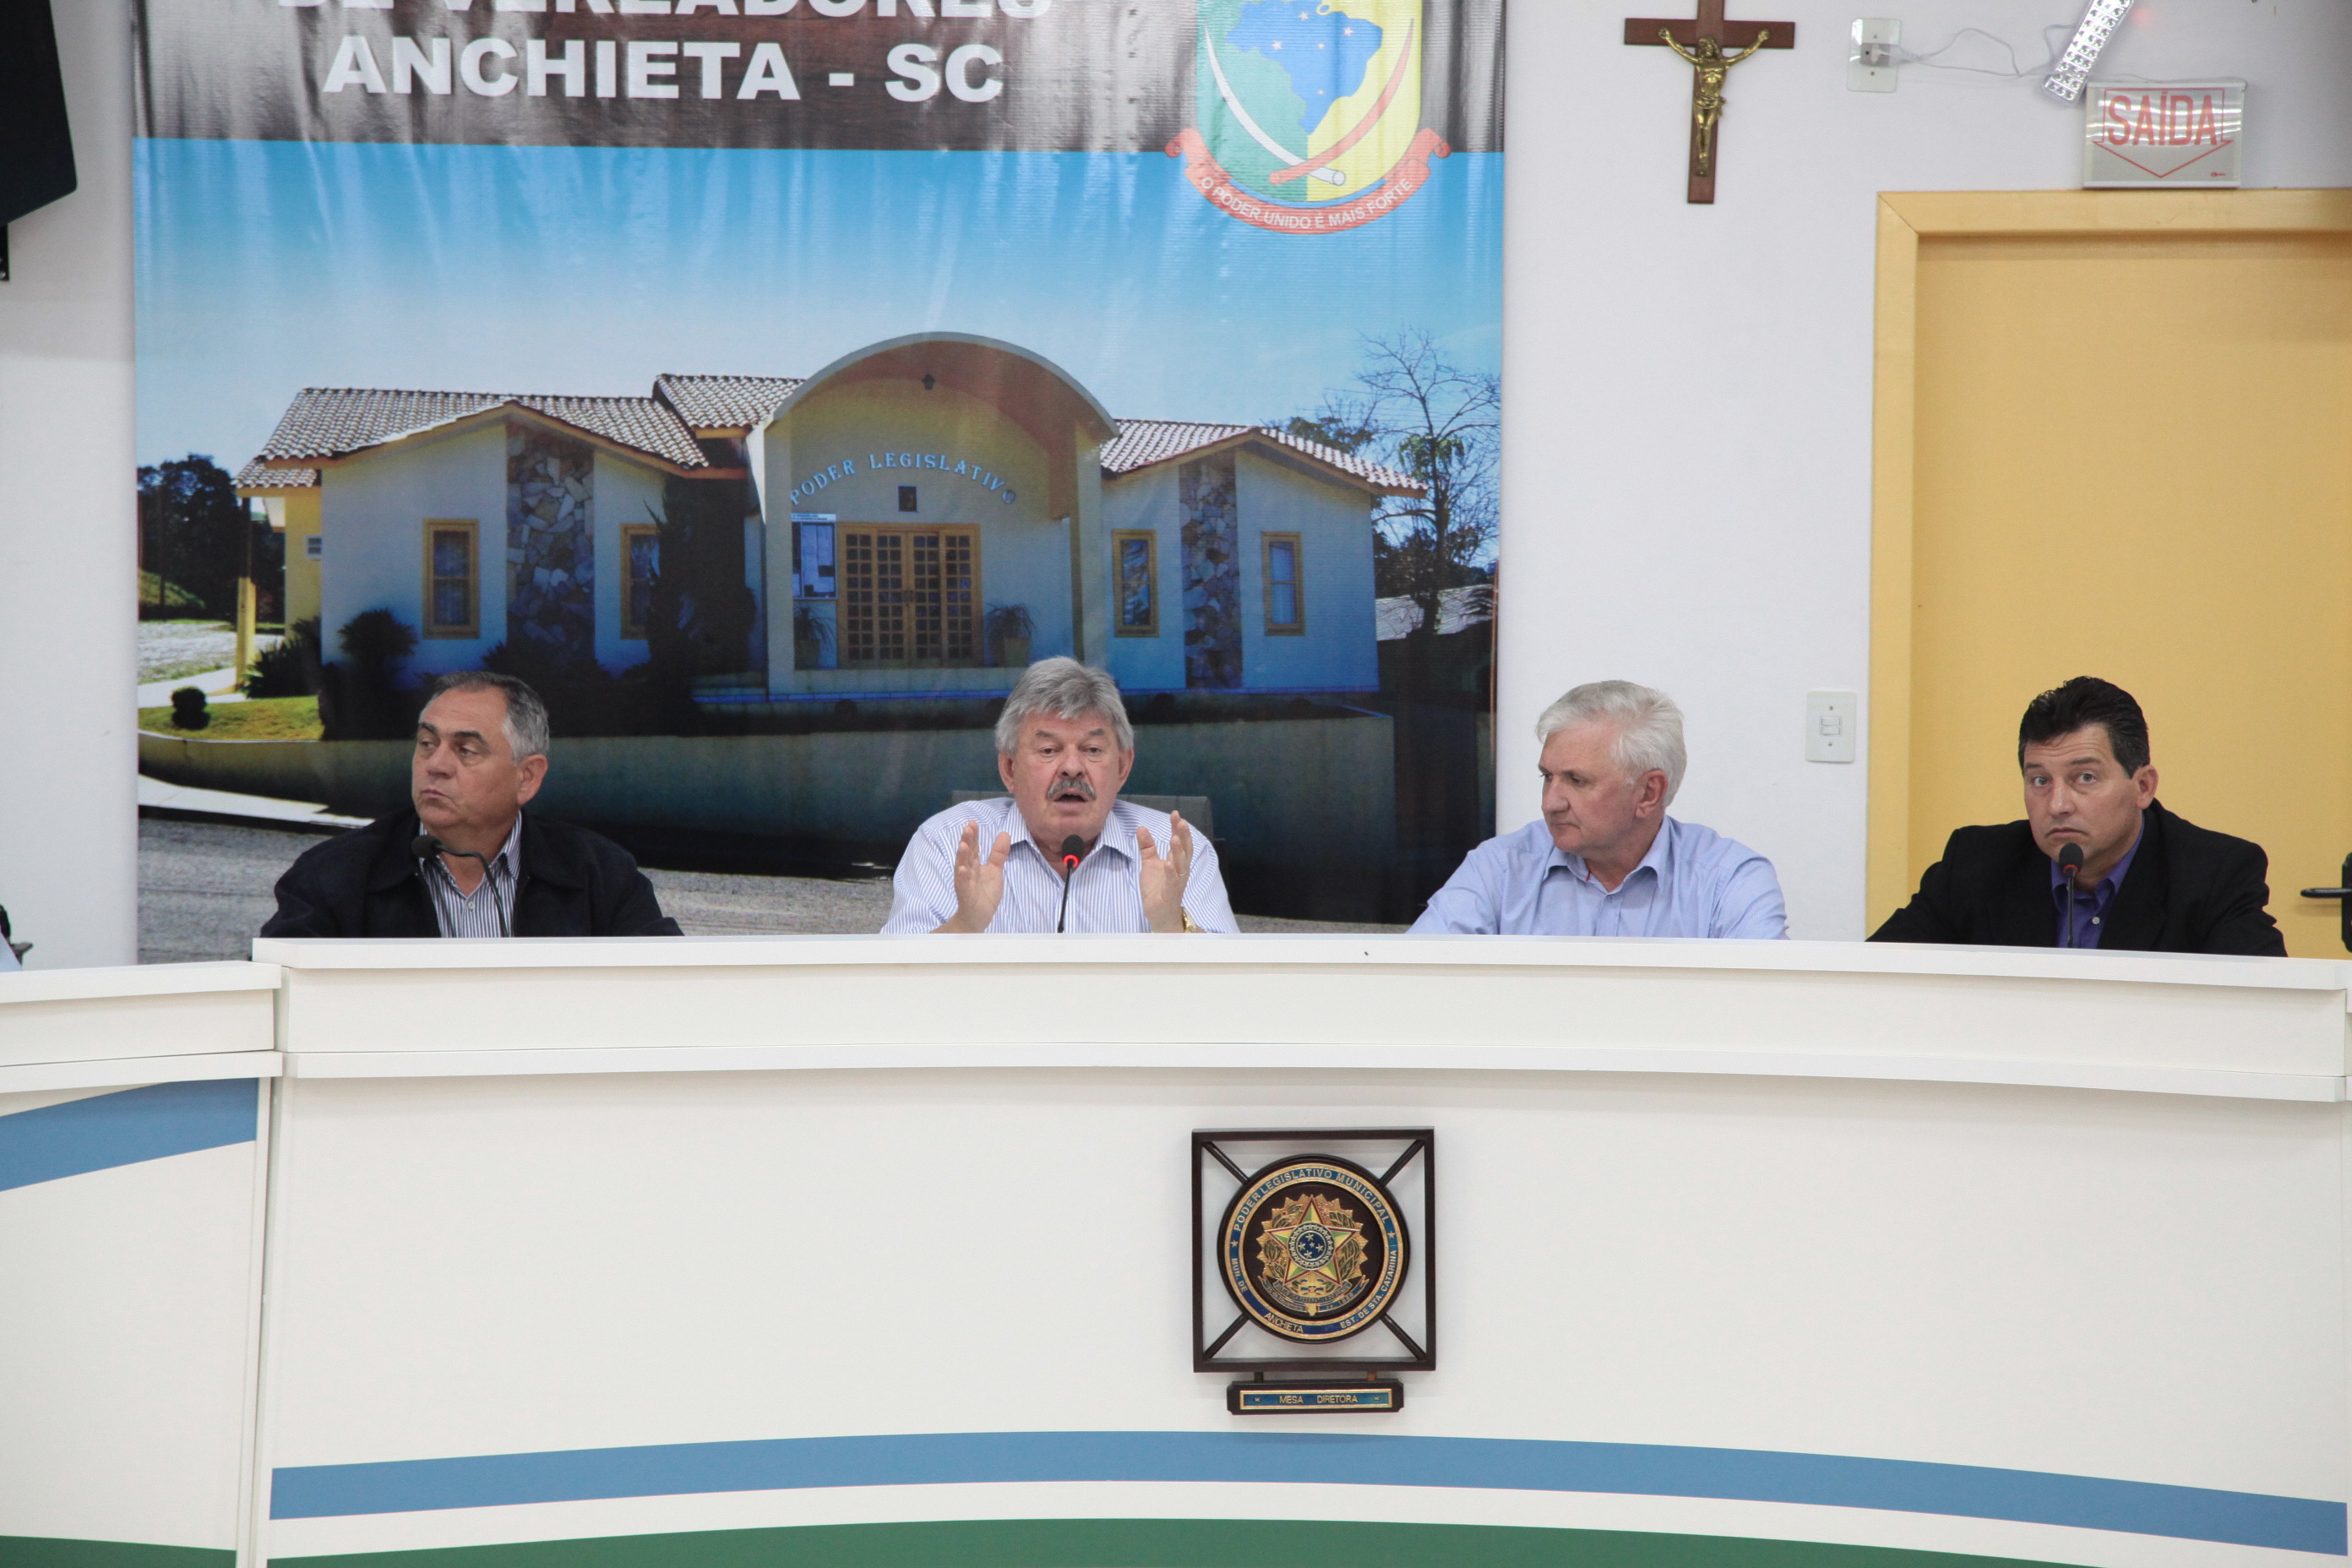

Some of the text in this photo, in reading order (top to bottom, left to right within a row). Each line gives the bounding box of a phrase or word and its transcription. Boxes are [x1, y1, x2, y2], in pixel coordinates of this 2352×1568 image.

[323, 35, 1005, 104] ANCHIETA - SC
[2107, 91, 2218, 146] SAÍDA
[1201, 177, 1214, 190] O
[1211, 184, 1261, 221] PODER
[1264, 213, 1310, 229] UNIDO
[1328, 208, 1365, 226] MAIS
[1366, 177, 1413, 215] FORTE
[790, 452, 1017, 506] PODER LEGISLATIVO
[1233, 1168, 1390, 1232] PODER LEGISLATIVO MUNICIPAL
[1231, 1258, 1241, 1280] MUN.
[1238, 1280, 1248, 1293] DE
[1340, 1317, 1359, 1329] EST.
[1358, 1307, 1369, 1319] DE
[1368, 1293, 1385, 1309] STA.
[1380, 1250, 1397, 1293] CATARINA
[1279, 1395, 1358, 1404] MESA DIRETORA
